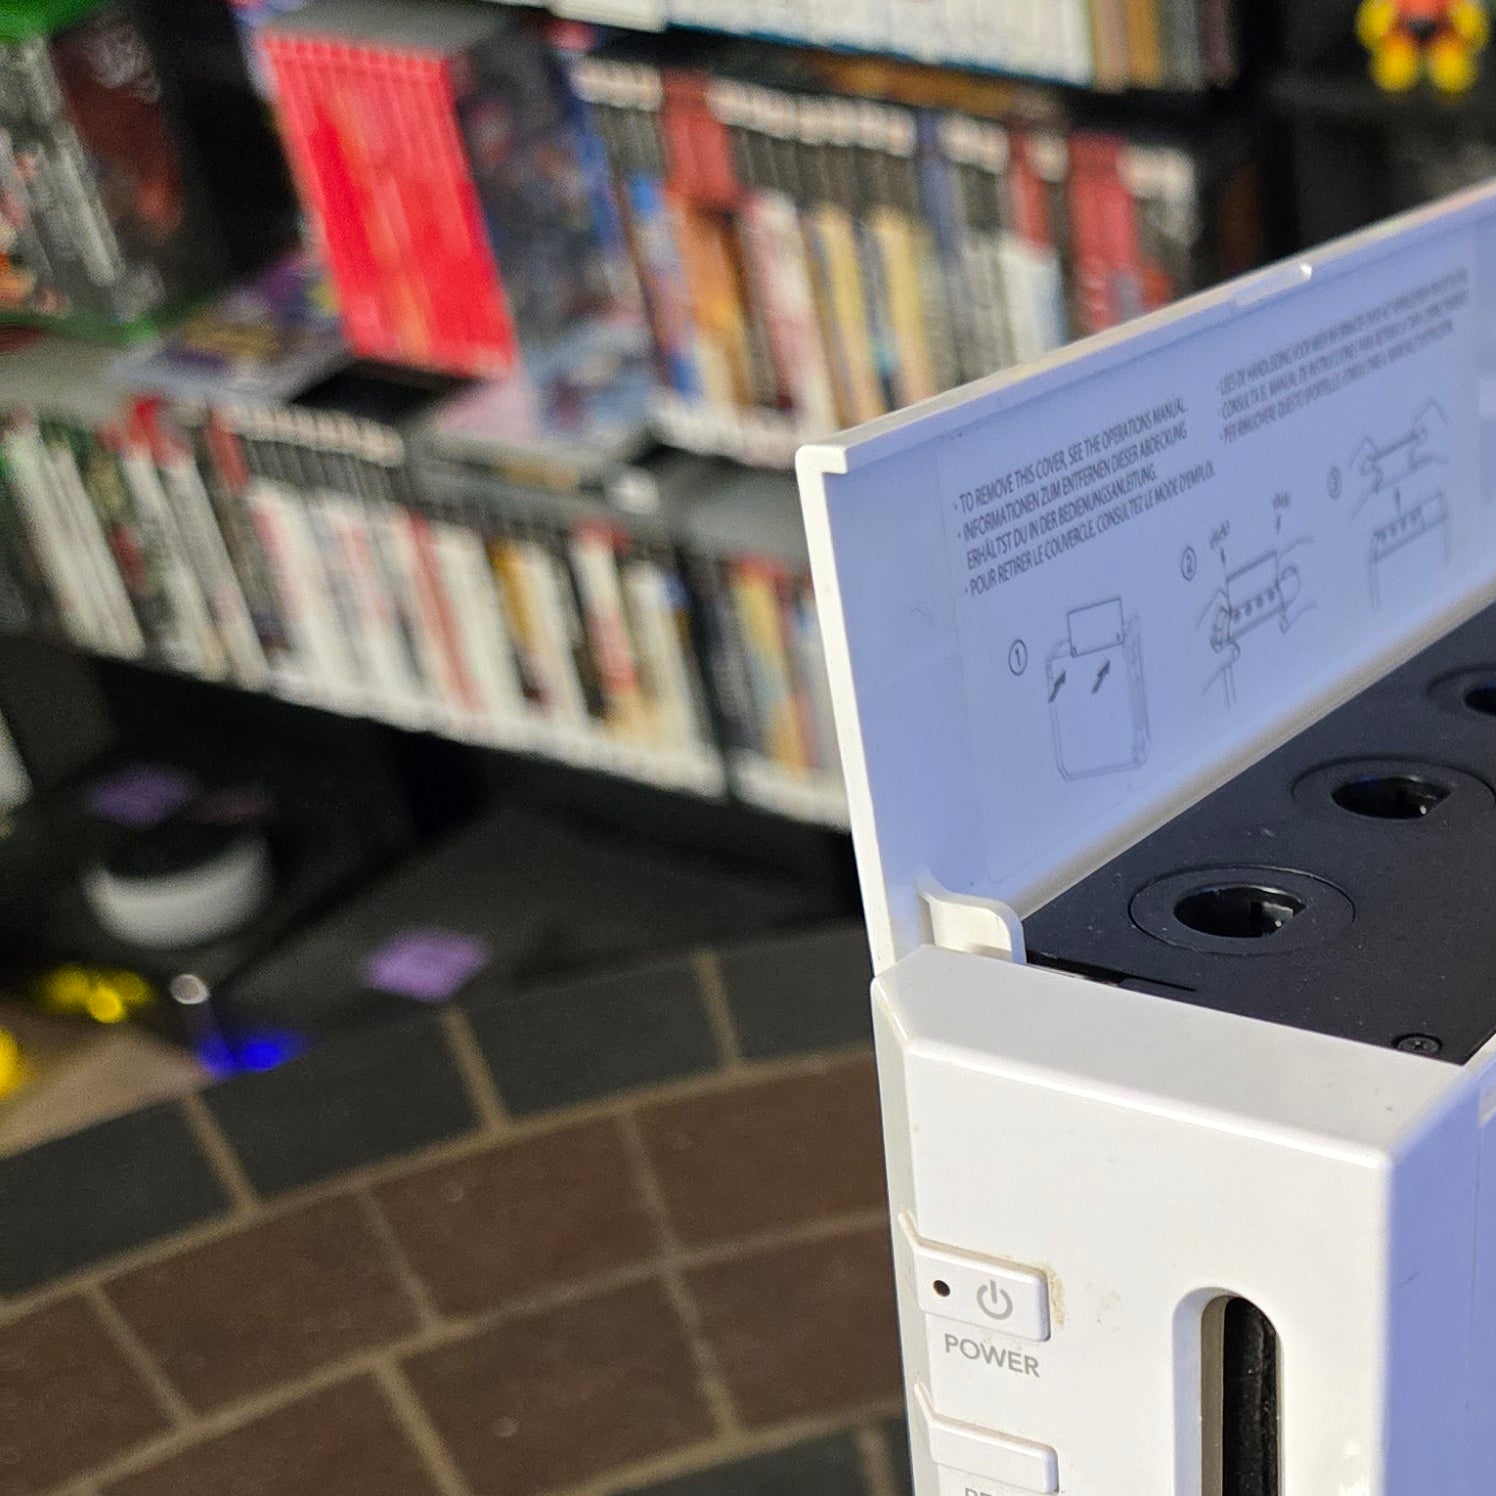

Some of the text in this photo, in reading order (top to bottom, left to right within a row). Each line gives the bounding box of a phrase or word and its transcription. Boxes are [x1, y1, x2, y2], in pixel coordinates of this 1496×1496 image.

[959, 491, 974, 514] TO
[975, 472, 1014, 508] REMOVE
[1014, 461, 1035, 489] THIS
[1068, 442, 1084, 467] SEE
[1082, 435, 1101, 460] THE
[1101, 415, 1151, 453] OPERATIONS
[963, 422, 1187, 542] INFORMATIONEN ZUM ENTFERNEN DIESER ABDECKUNG
[966, 527, 1012, 570] ERHÄLTST
[1012, 521, 1030, 547] DU
[1039, 508, 1059, 535] DER
[969, 570, 997, 597] POUR
[998, 551, 1034, 583] RETIRER
[1033, 543, 1044, 566] LE
[1096, 495, 1143, 534] CONSULTEZ
[1154, 477, 1179, 506] MODE
[944, 1332, 1040, 1378] POWER
